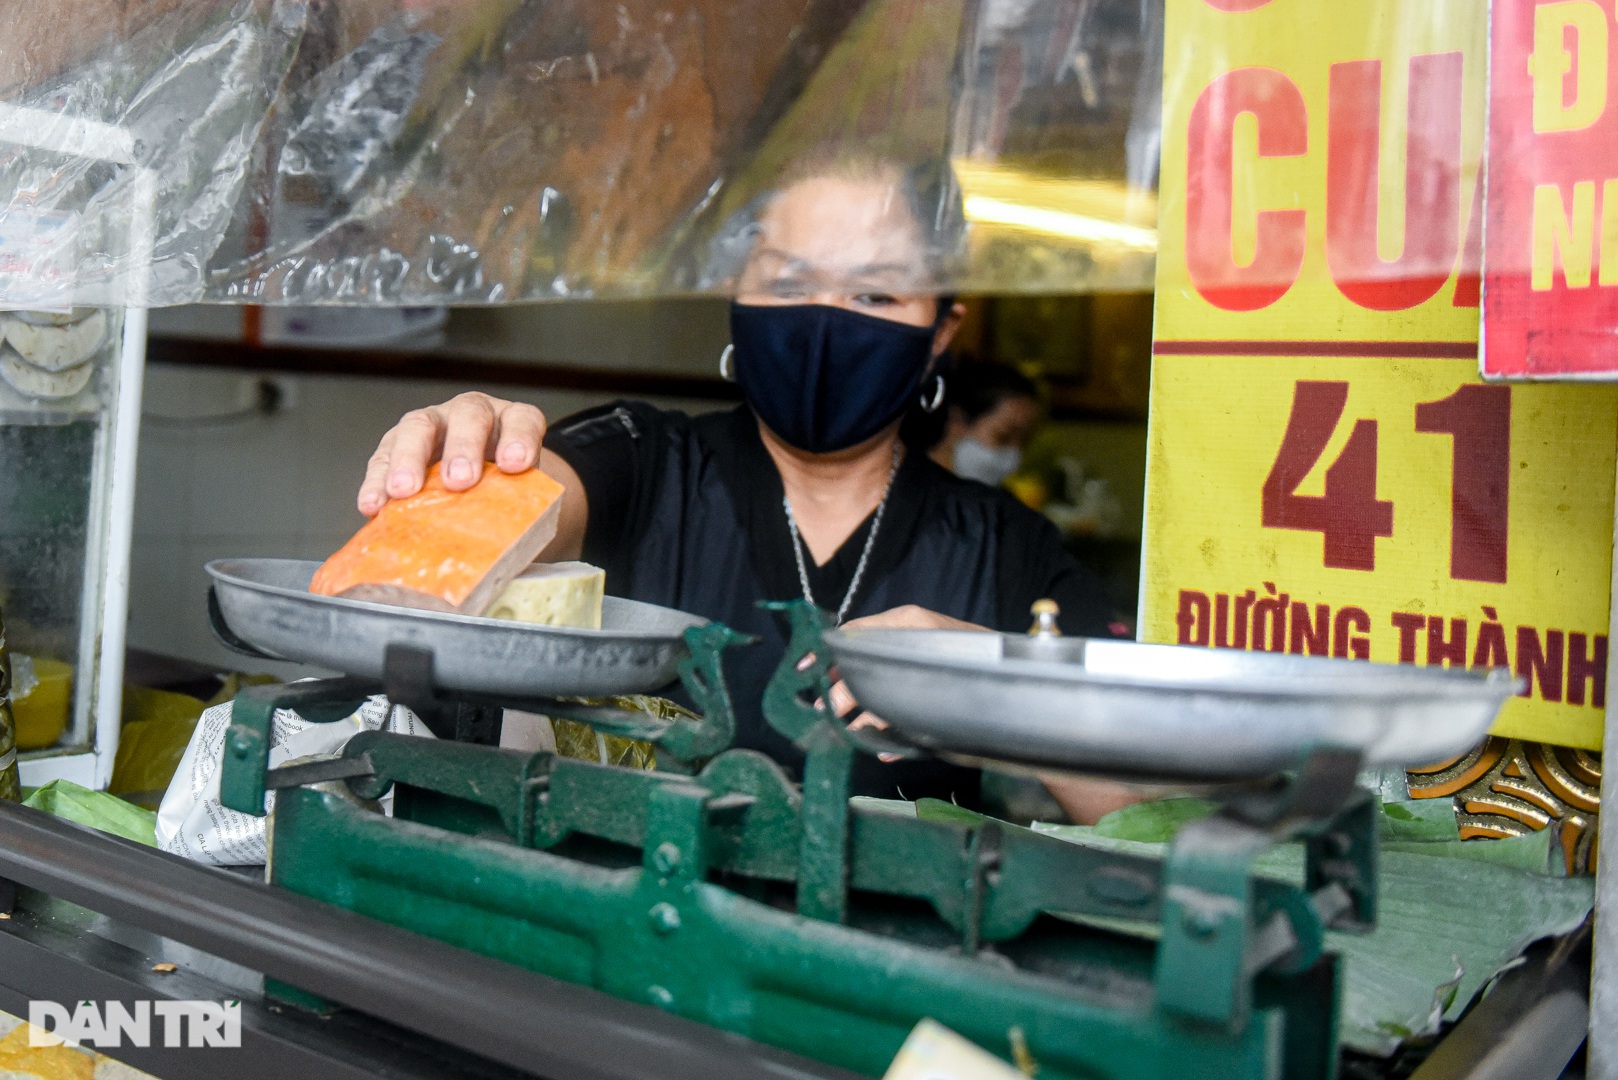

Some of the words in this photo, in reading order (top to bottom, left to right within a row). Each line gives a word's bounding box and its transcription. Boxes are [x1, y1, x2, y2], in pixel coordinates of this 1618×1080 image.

[1185, 50, 1482, 312] CU
[1261, 380, 1512, 584] 41
[1175, 581, 1371, 661] ĐƯỜNG
[1391, 606, 1608, 708] THÀNH
